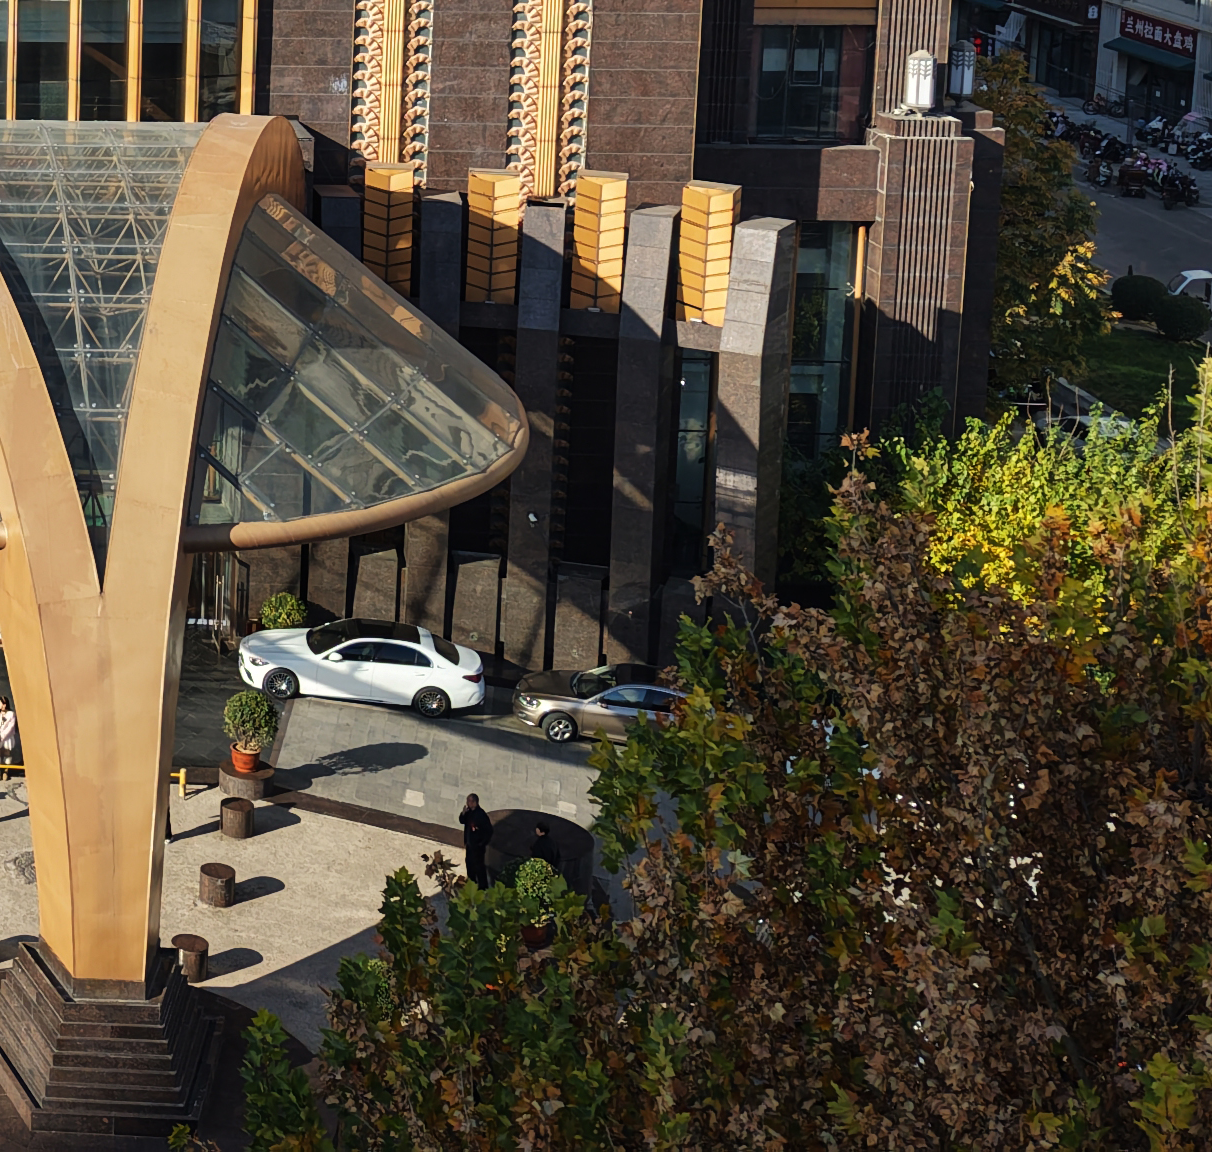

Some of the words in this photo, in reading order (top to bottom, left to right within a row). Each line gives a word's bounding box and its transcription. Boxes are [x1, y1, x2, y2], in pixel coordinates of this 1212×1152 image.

[1125, 16, 1194, 53] 兰州拉面大盘鸡
